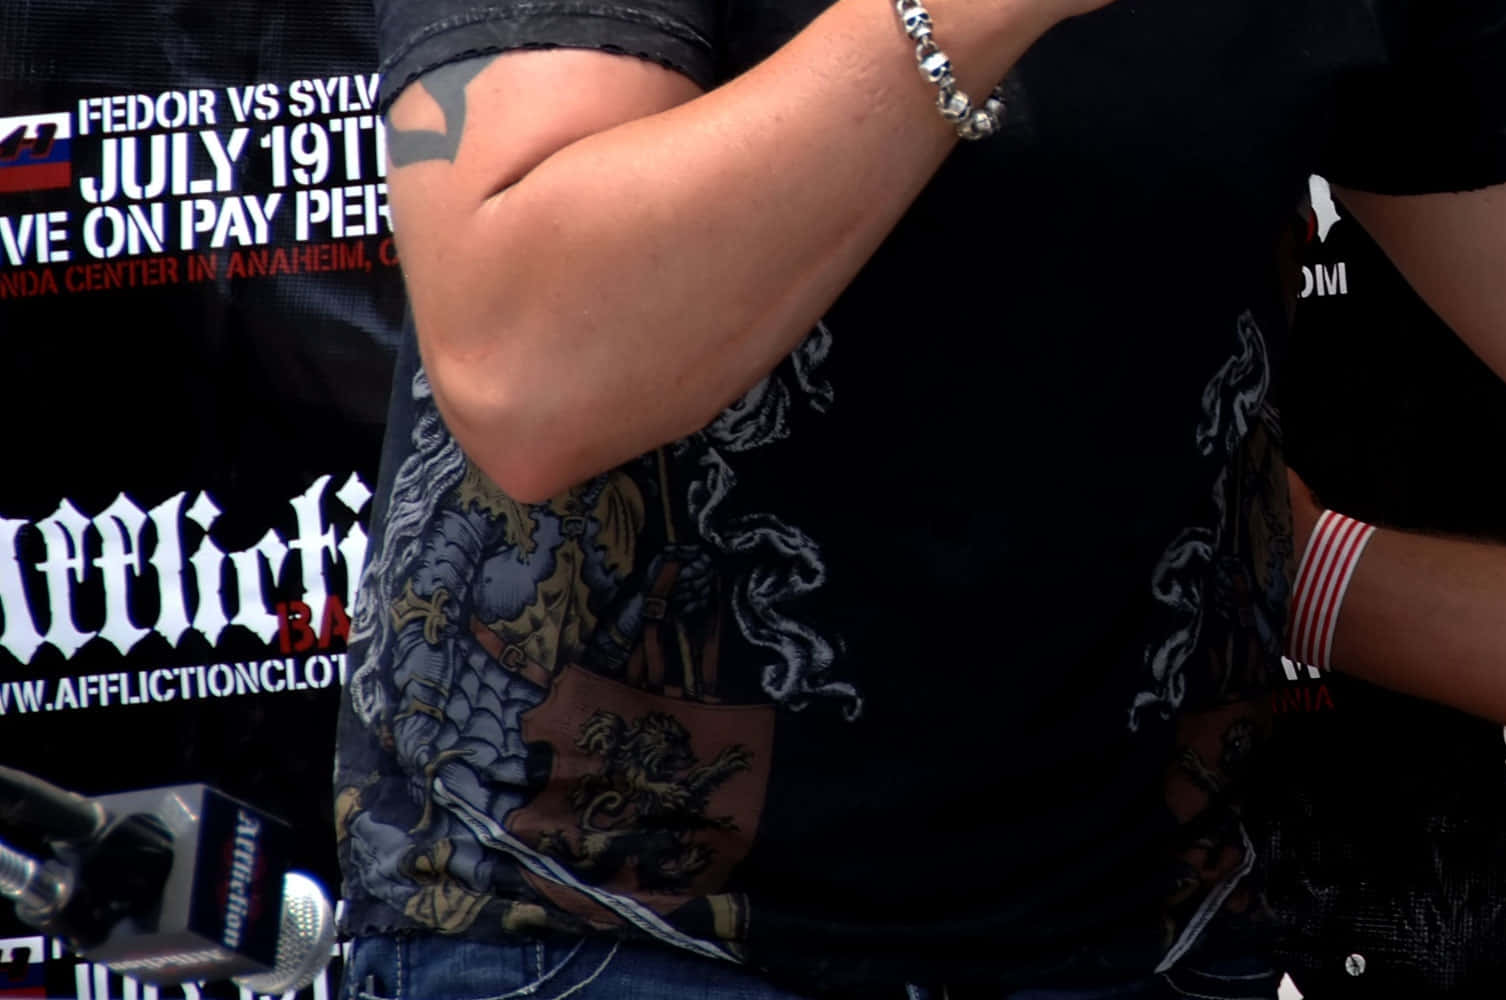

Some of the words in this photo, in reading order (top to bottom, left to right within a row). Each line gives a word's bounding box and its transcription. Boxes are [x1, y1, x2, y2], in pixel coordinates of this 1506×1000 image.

[78, 89, 217, 136] FEDOR
[226, 83, 279, 123] VS
[289, 73, 380, 115] SYLV
[79, 127, 250, 202] JULY
[83, 203, 164, 259] ON
[180, 192, 282, 250] PAY
[295, 183, 394, 241] PER
[65, 257, 180, 293] CENTER
[187, 255, 217, 282] IN
[226, 245, 373, 279] ANAHEIM,
